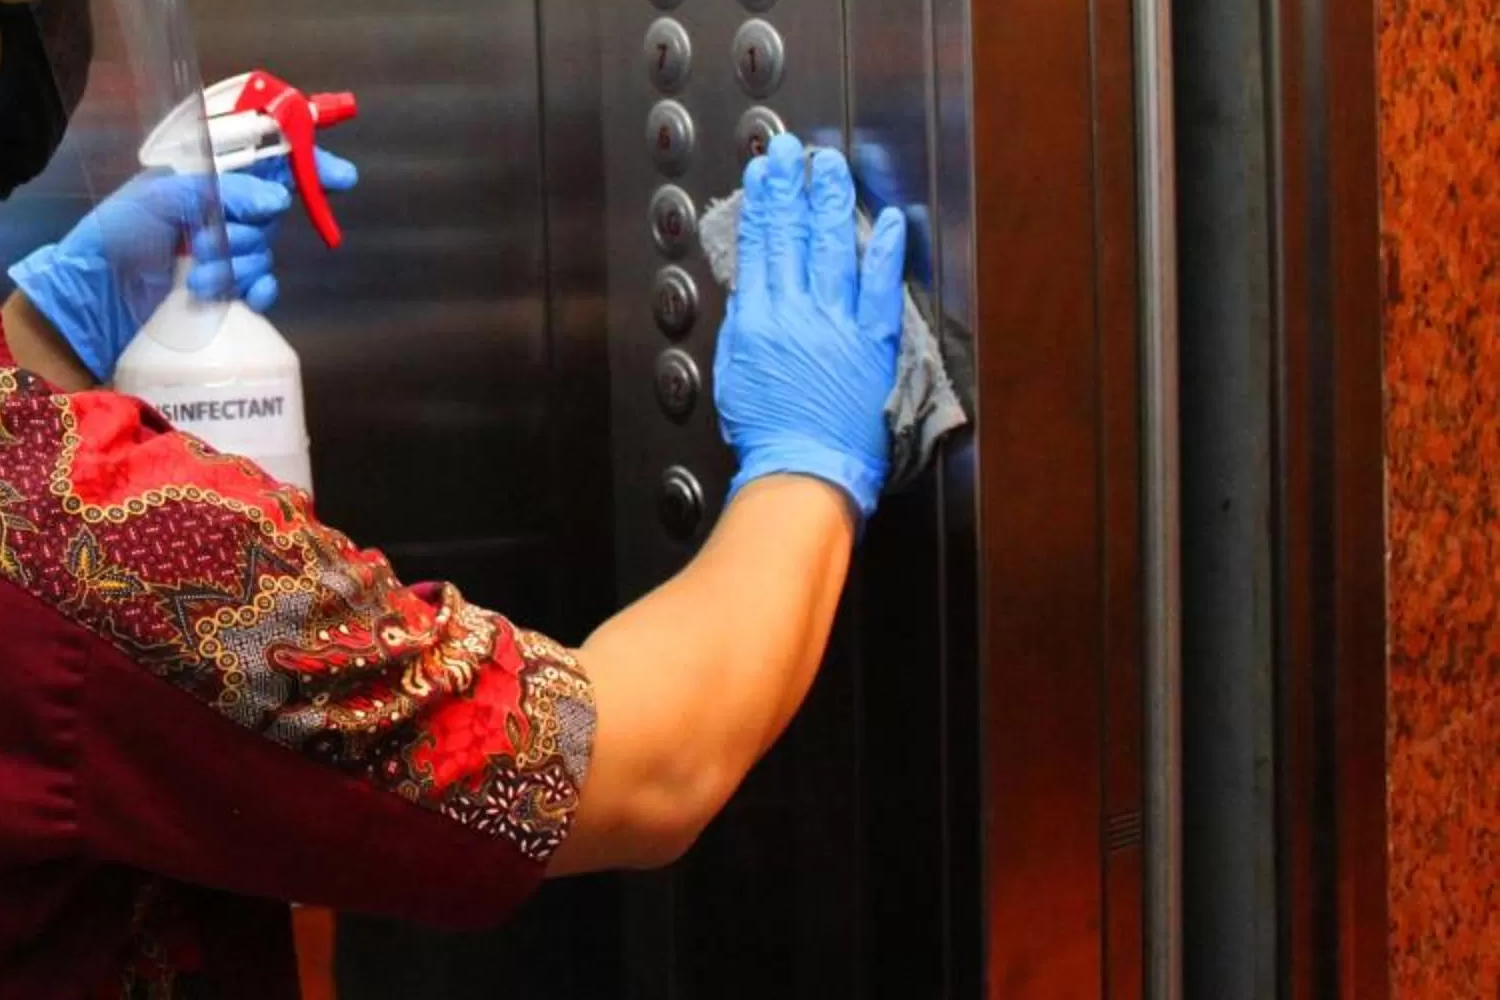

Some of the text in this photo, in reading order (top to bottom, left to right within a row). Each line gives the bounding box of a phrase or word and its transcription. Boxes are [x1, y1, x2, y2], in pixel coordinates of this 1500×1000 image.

[656, 42, 669, 71] 7
[748, 45, 758, 73] 1
[156, 396, 285, 423] SINFECTANT
